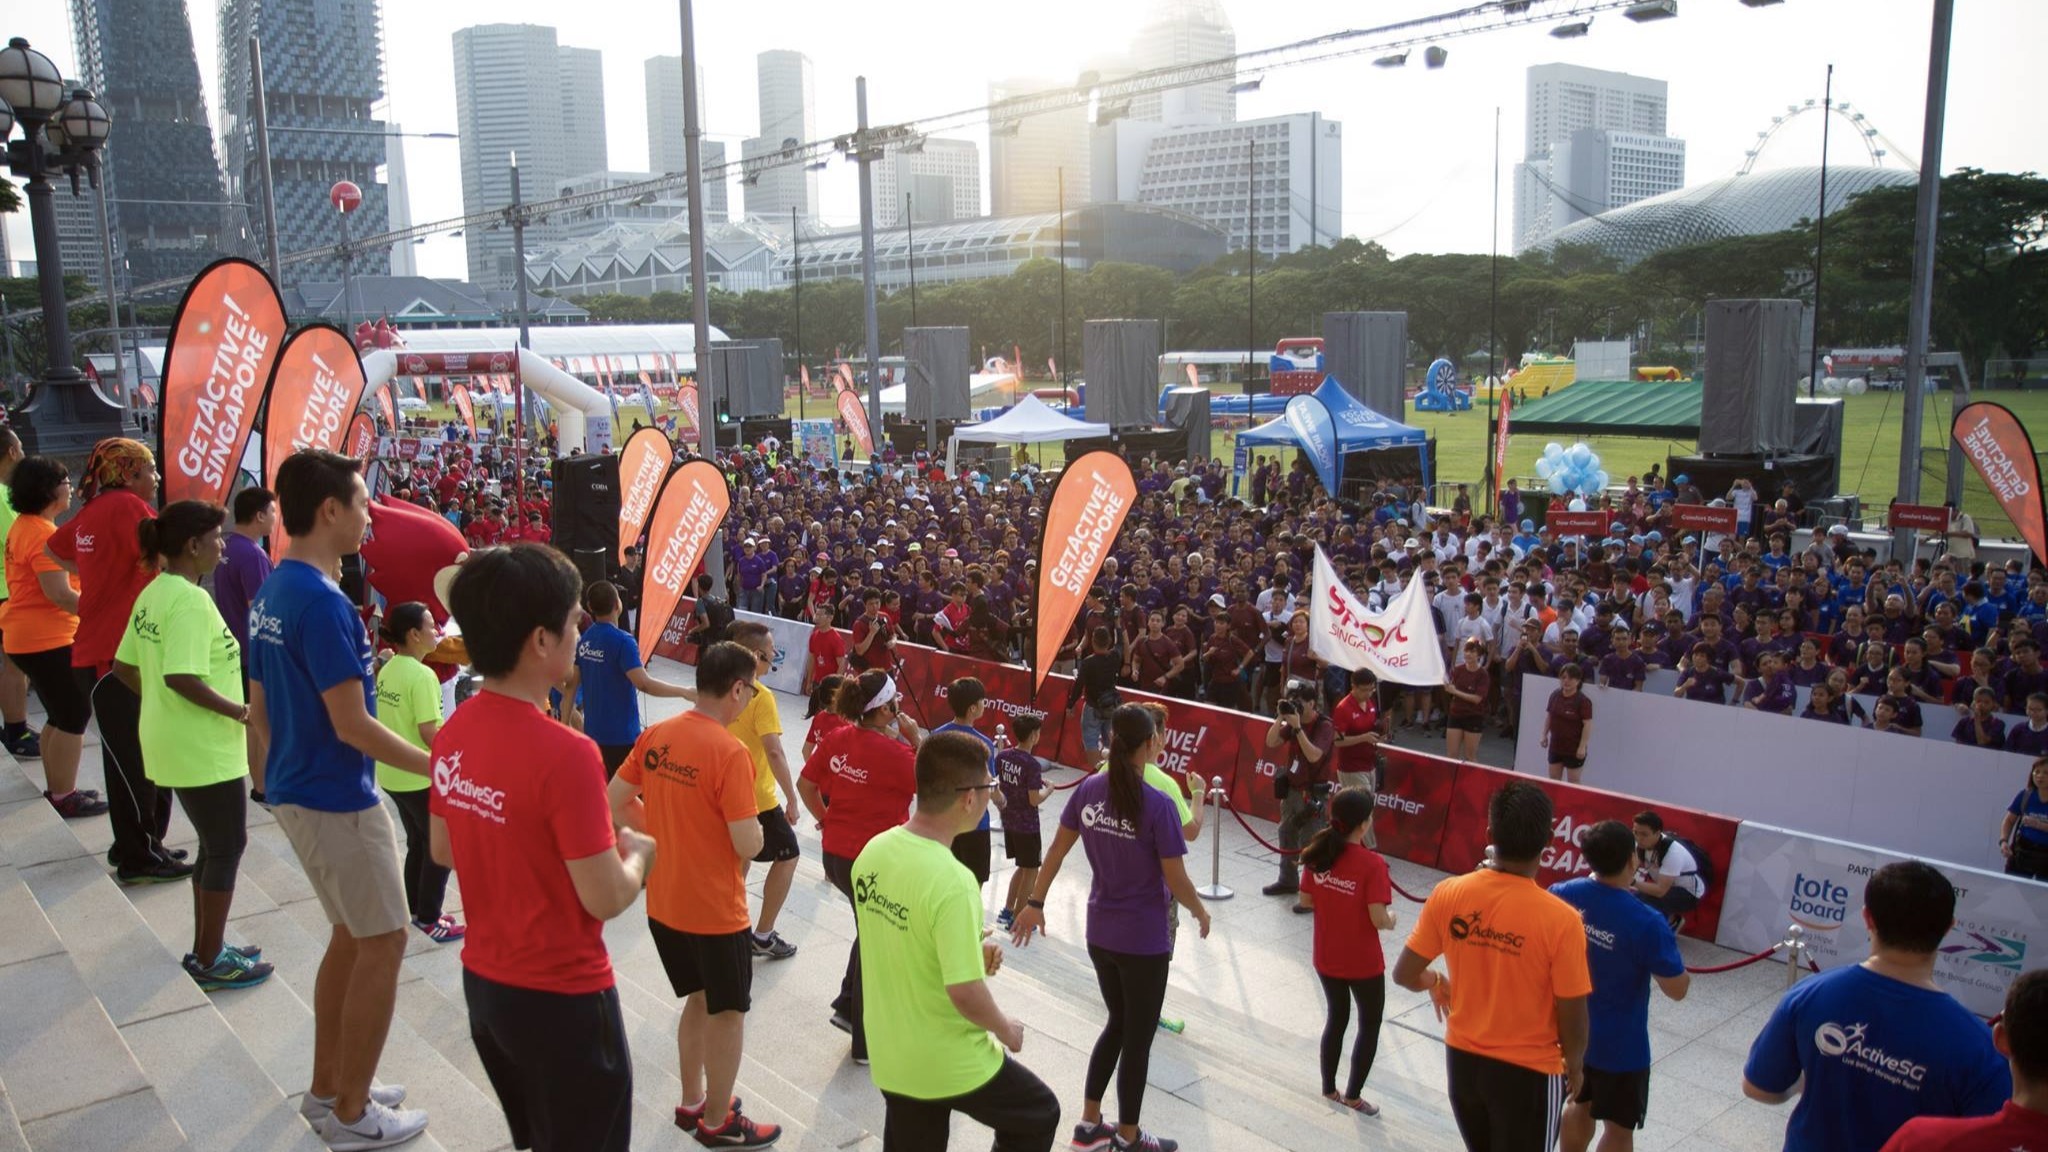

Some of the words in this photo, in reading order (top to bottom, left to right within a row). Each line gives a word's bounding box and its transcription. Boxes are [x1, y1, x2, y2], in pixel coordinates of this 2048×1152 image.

[178, 293, 250, 477] GETACTIVE!
[203, 327, 269, 490] SINGAPORE
[291, 352, 335, 454] ACTIVE!
[591, 483, 608, 491] CODA
[620, 441, 658, 522] GETACTIVE!
[631, 455, 665, 528] SINGAPORE
[652, 479, 708, 585] GETACTIVE!
[666, 501, 719, 595] SINGAPORE
[1050, 470, 1111, 587] GETACTIVE!
[1066, 492, 1124, 596] SINGAPORE
[449, 773, 506, 811] ActiveSG
[1000, 759, 1022, 776] TEAM
[1790, 895, 1846, 922] board
[1794, 872, 1848, 905] tote
[1470, 925, 1525, 948] ActiveSG
[1948, 972, 1974, 985] Board
[1976, 979, 2003, 992] Group
[1842, 1055, 1854, 1065] Live
[1875, 1067, 1901, 1084] through
[1847, 1039, 1927, 1081] ActiveSG
